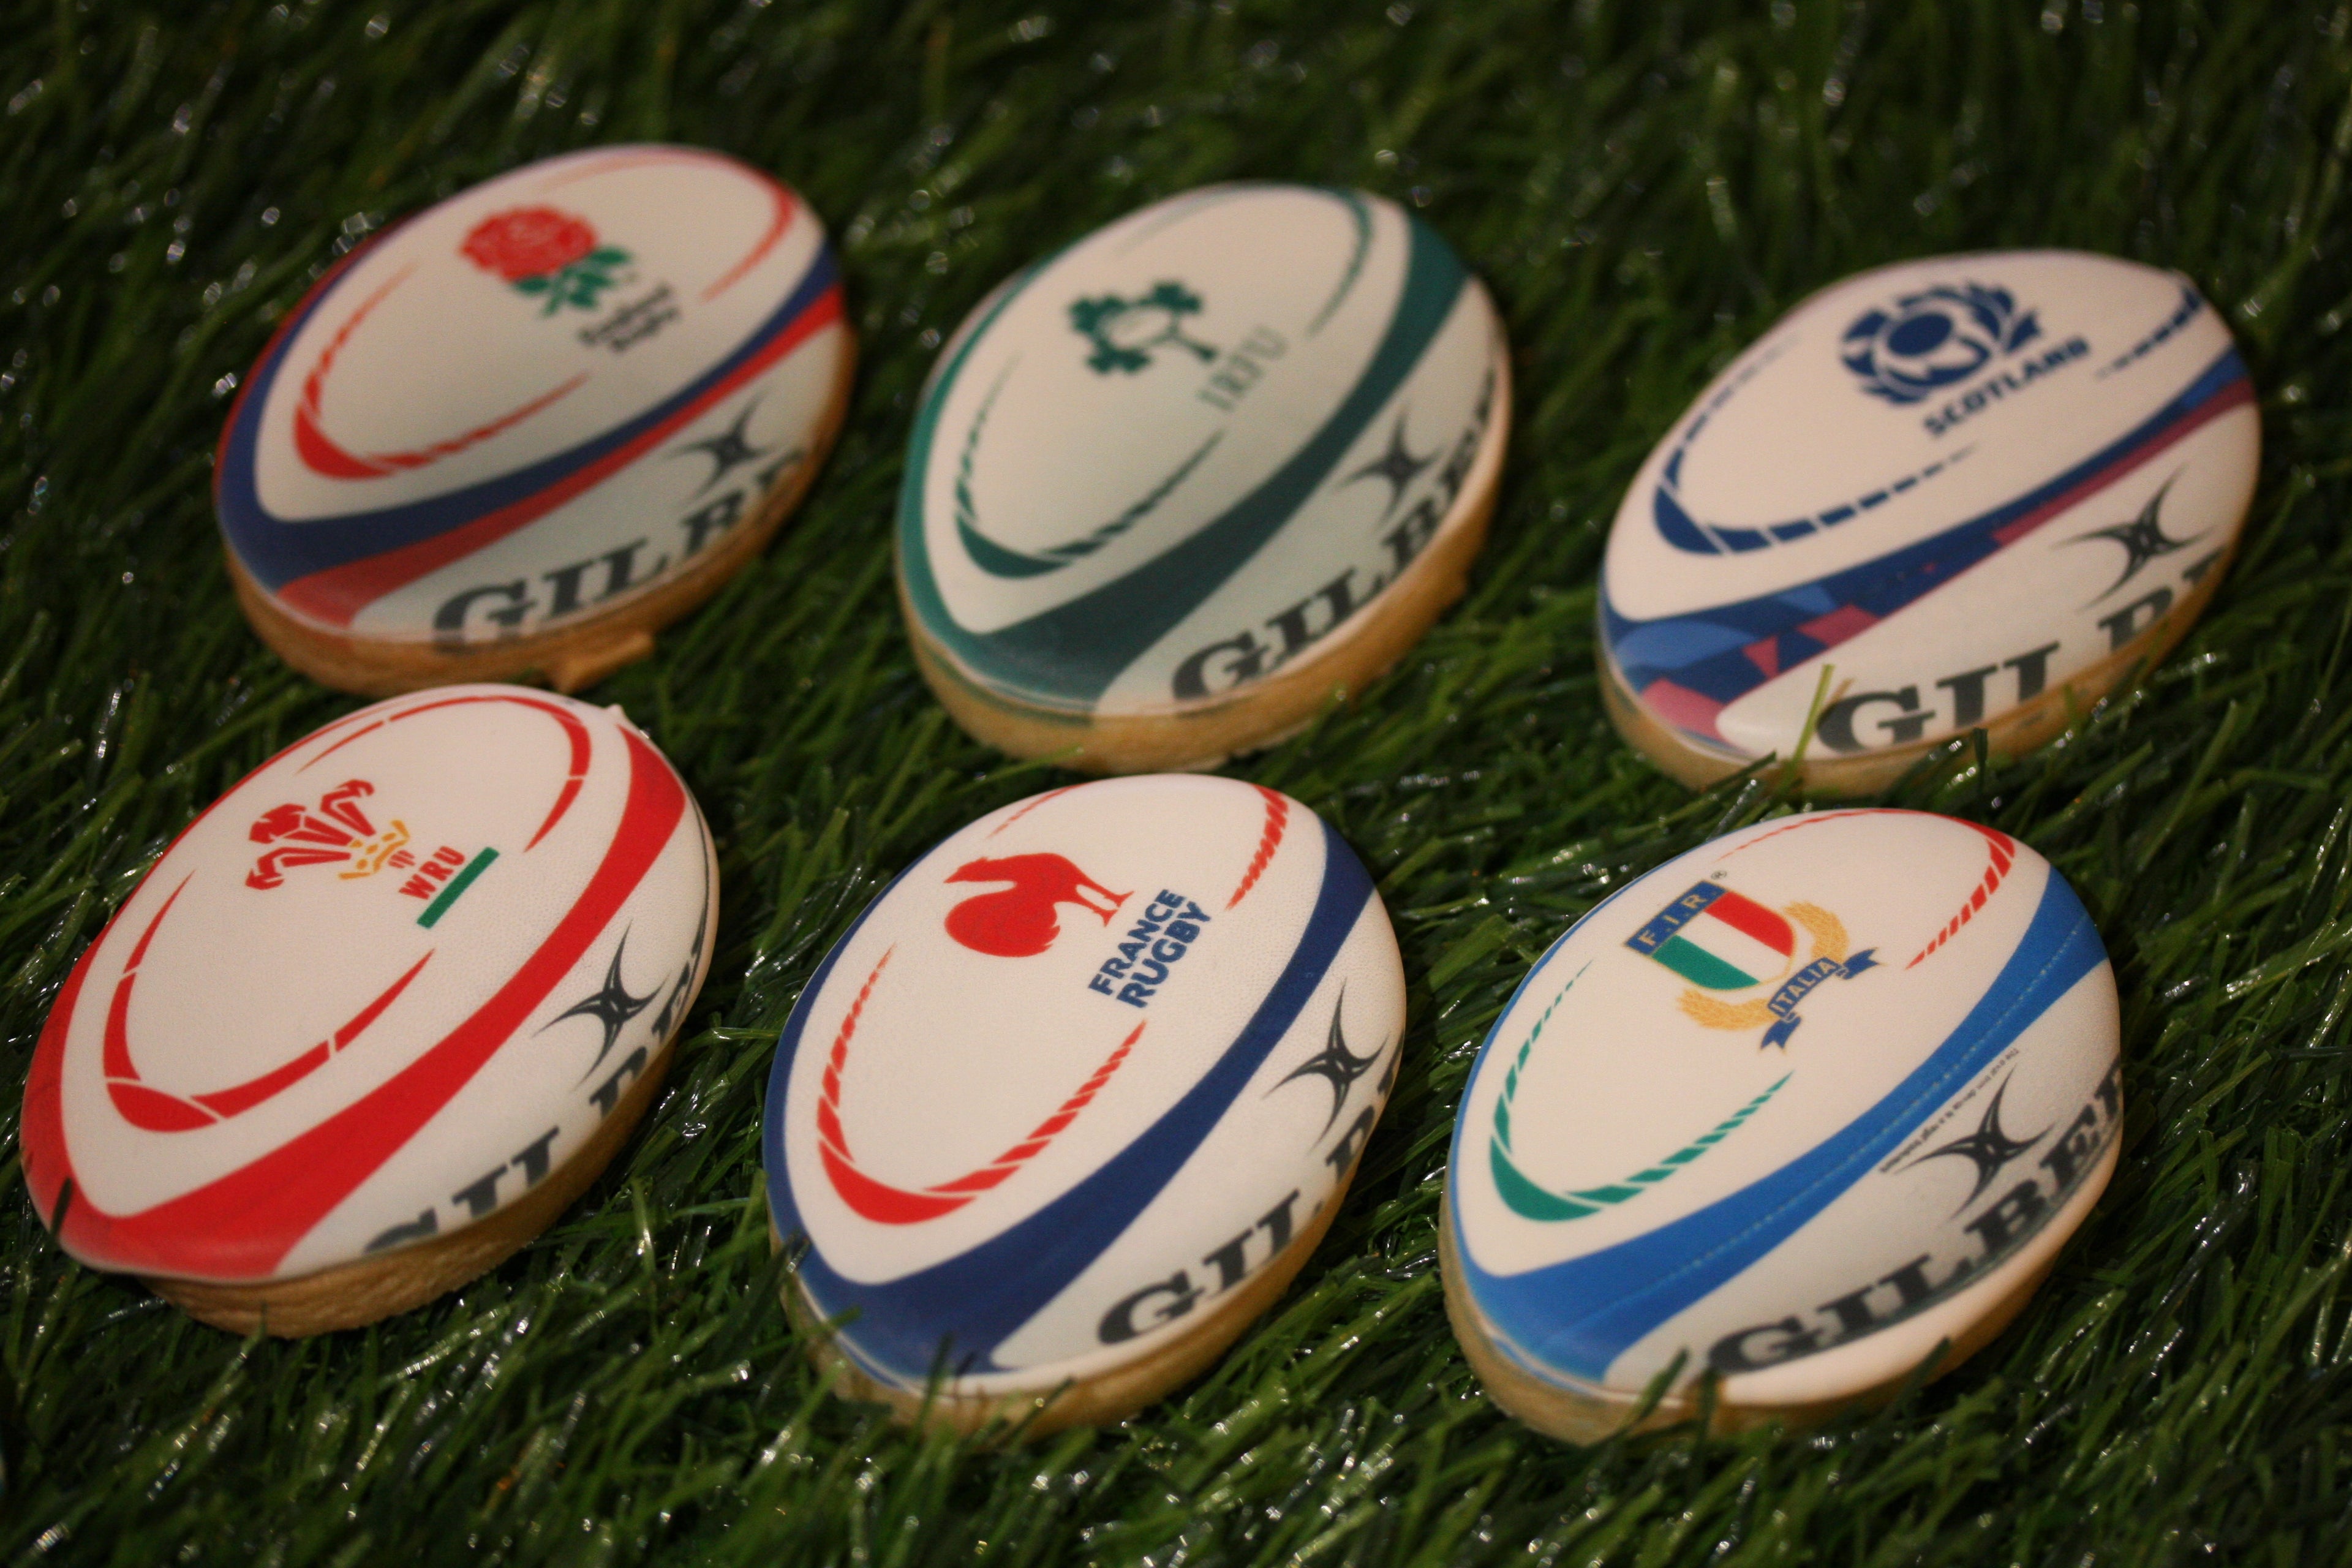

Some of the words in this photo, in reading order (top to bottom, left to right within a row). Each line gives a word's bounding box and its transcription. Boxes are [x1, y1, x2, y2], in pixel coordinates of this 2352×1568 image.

[1924, 337, 2089, 437] SCOTLAND
[398, 846, 466, 900] WRU
[1088, 889, 1186, 996] FRANCE
[1116, 901, 1212, 1008] RUGBY
[1771, 961, 1836, 1013] ITALIA
